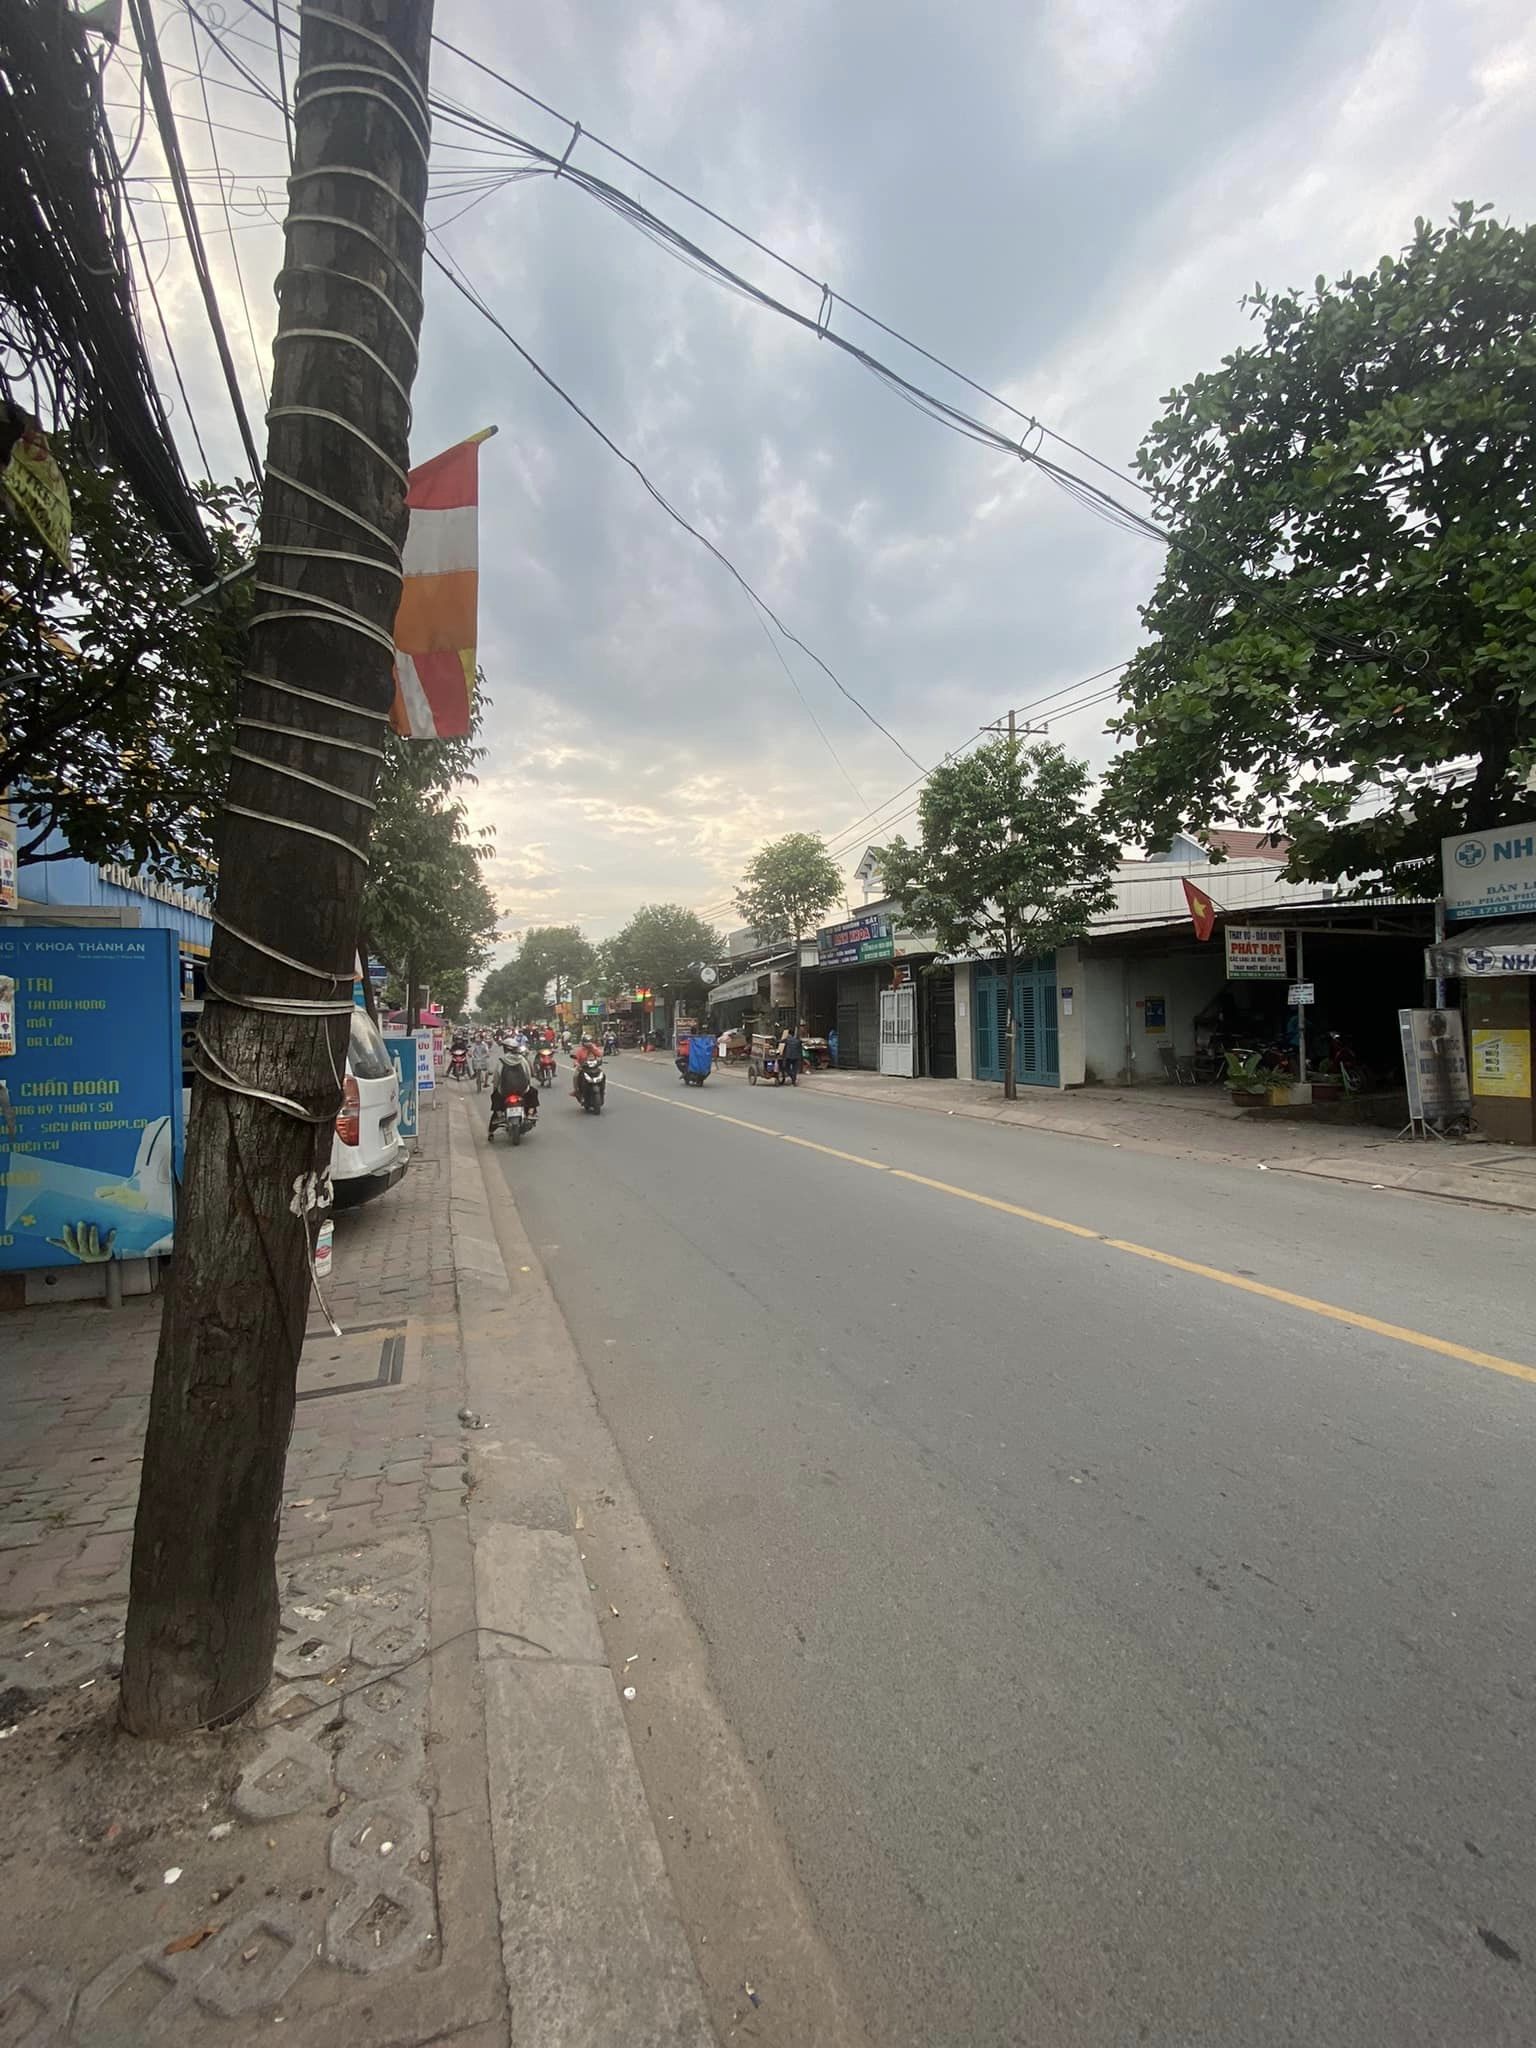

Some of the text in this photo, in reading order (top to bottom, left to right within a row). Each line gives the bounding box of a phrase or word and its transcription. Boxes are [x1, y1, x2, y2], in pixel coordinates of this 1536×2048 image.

[1493, 837, 1536, 862] NH
[36, 942, 75, 952] KHOA
[127, 943, 145, 953] AN
